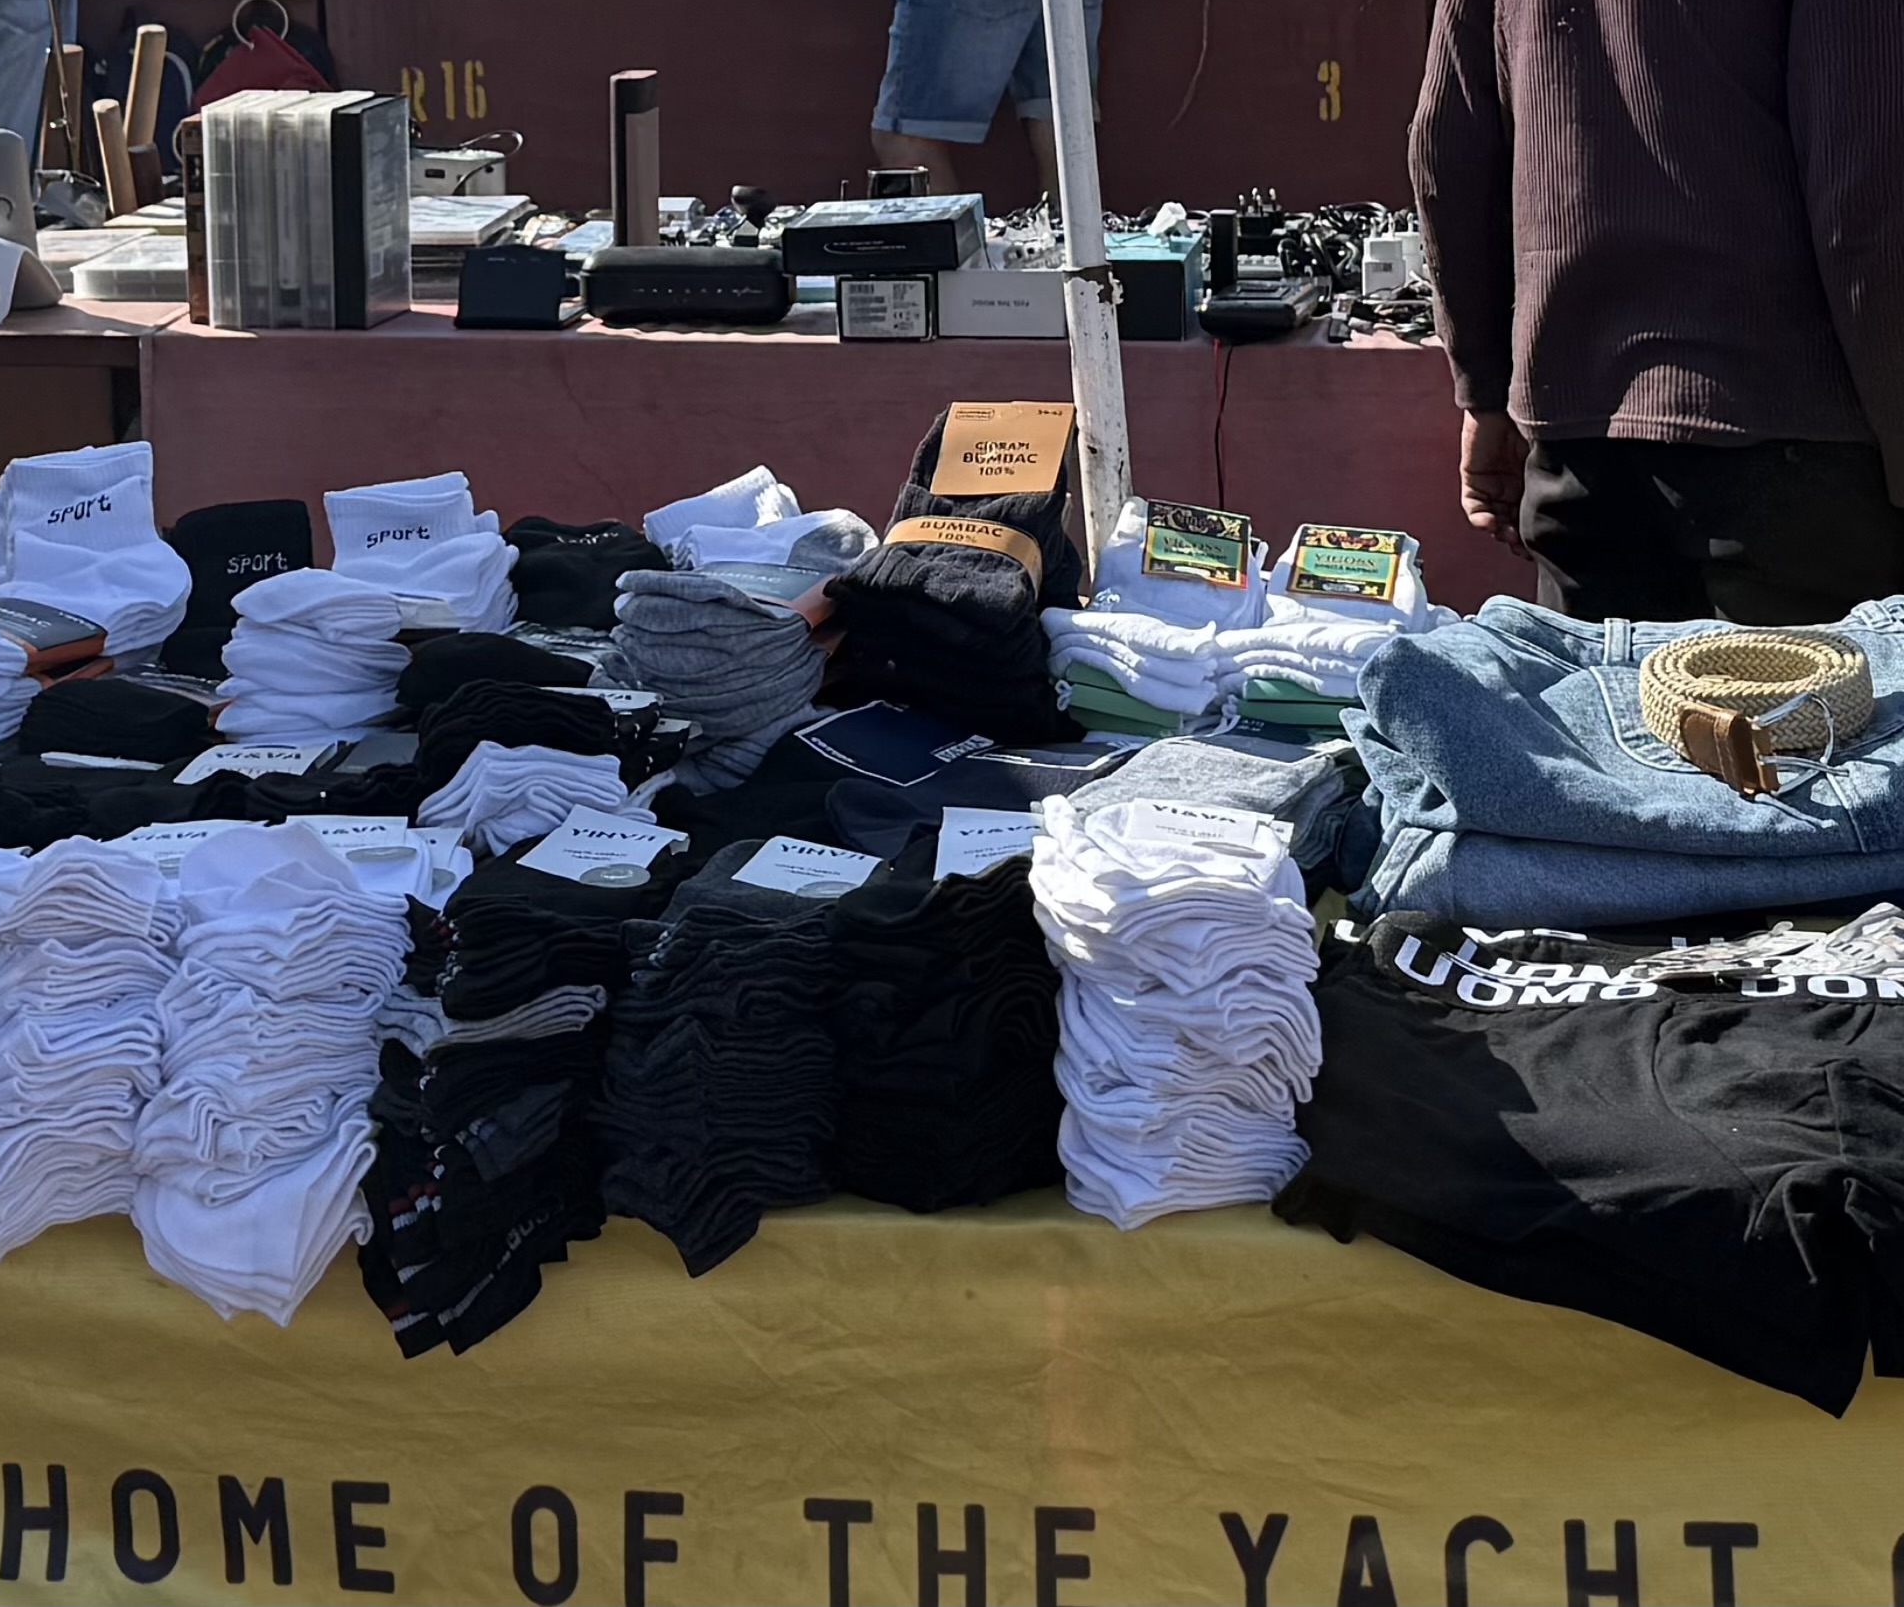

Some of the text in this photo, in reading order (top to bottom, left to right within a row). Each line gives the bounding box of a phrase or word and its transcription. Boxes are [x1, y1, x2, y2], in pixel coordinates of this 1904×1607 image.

[441, 59, 488, 121] 16
[1317, 60, 1342, 122] 3
[919, 520, 1004, 538] BUMBAC
[1395, 933, 1659, 1008] UOMO
[510, 1484, 686, 1607] OF
[803, 1497, 1099, 1607] THE
[1218, 1510, 1759, 1607] YACHT
